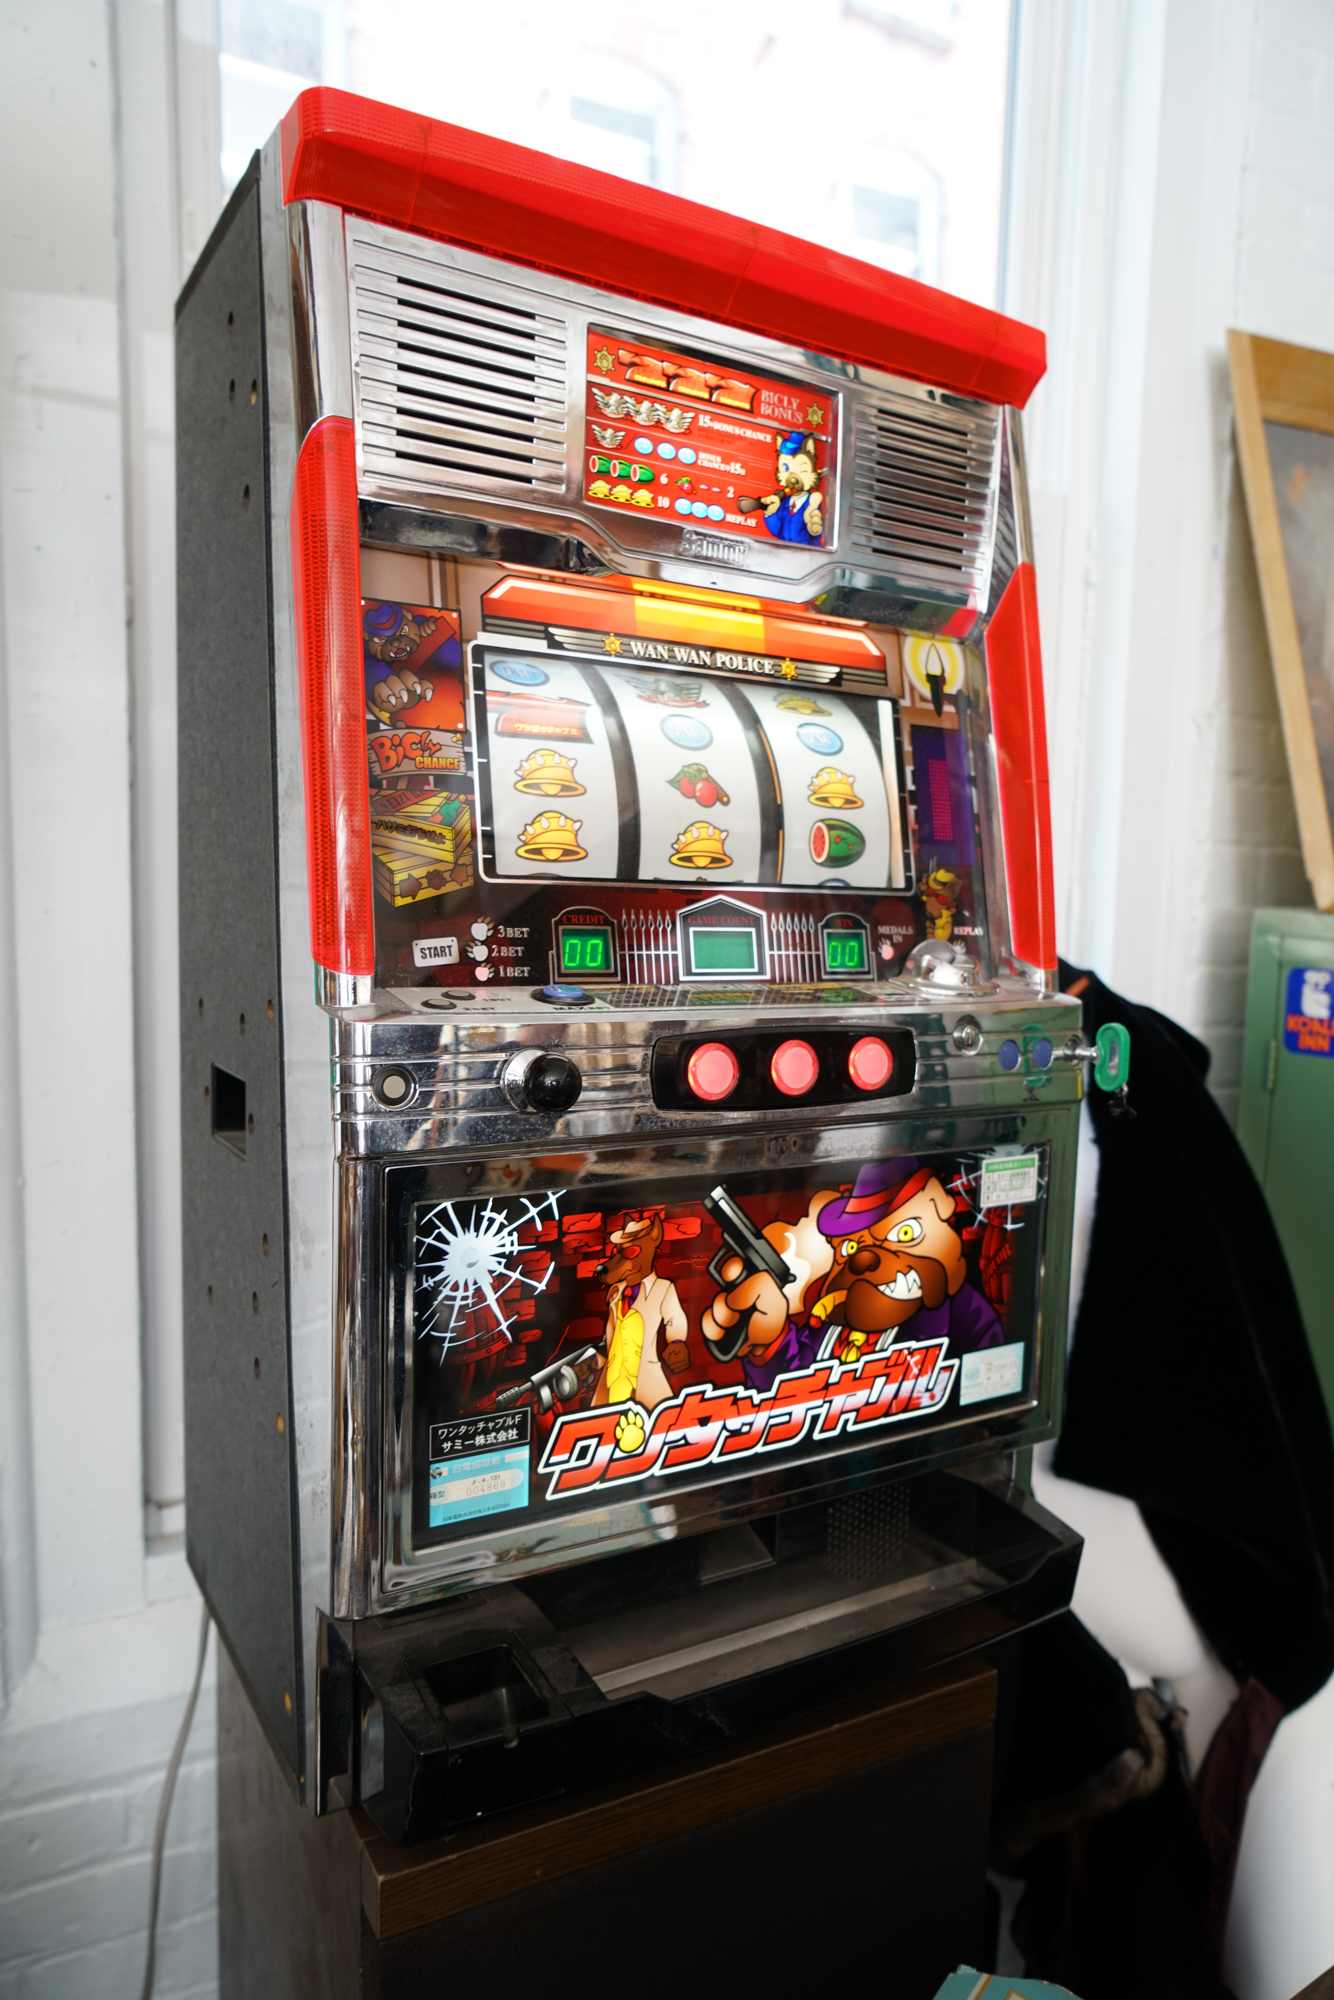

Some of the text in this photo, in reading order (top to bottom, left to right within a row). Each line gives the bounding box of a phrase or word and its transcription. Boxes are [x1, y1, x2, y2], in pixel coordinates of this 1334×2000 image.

[760, 403, 803, 424] BONUS
[660, 473, 734, 499] 6 2
[657, 496, 670, 509] 10
[725, 513, 757, 528] REPLAY
[629, 640, 775, 676] WAN WAN POLICE
[415, 756, 460, 770] CHANCE
[562, 914, 605, 925] CREDIT
[687, 915, 755, 926] GAME COUNT
[834, 918, 854, 928] WIN
[877, 925, 914, 936] MEDALS
[953, 925, 984, 937] REPLAY
[892, 934, 903, 943] IN
[420, 945, 453, 959] START
[1298, 1034, 1330, 1053] INN
[438, 1414, 523, 1439] ワンタッチャブルF
[442, 1428, 519, 1453] サミー株式会社
[466, 1481, 506, 1496] 004869
